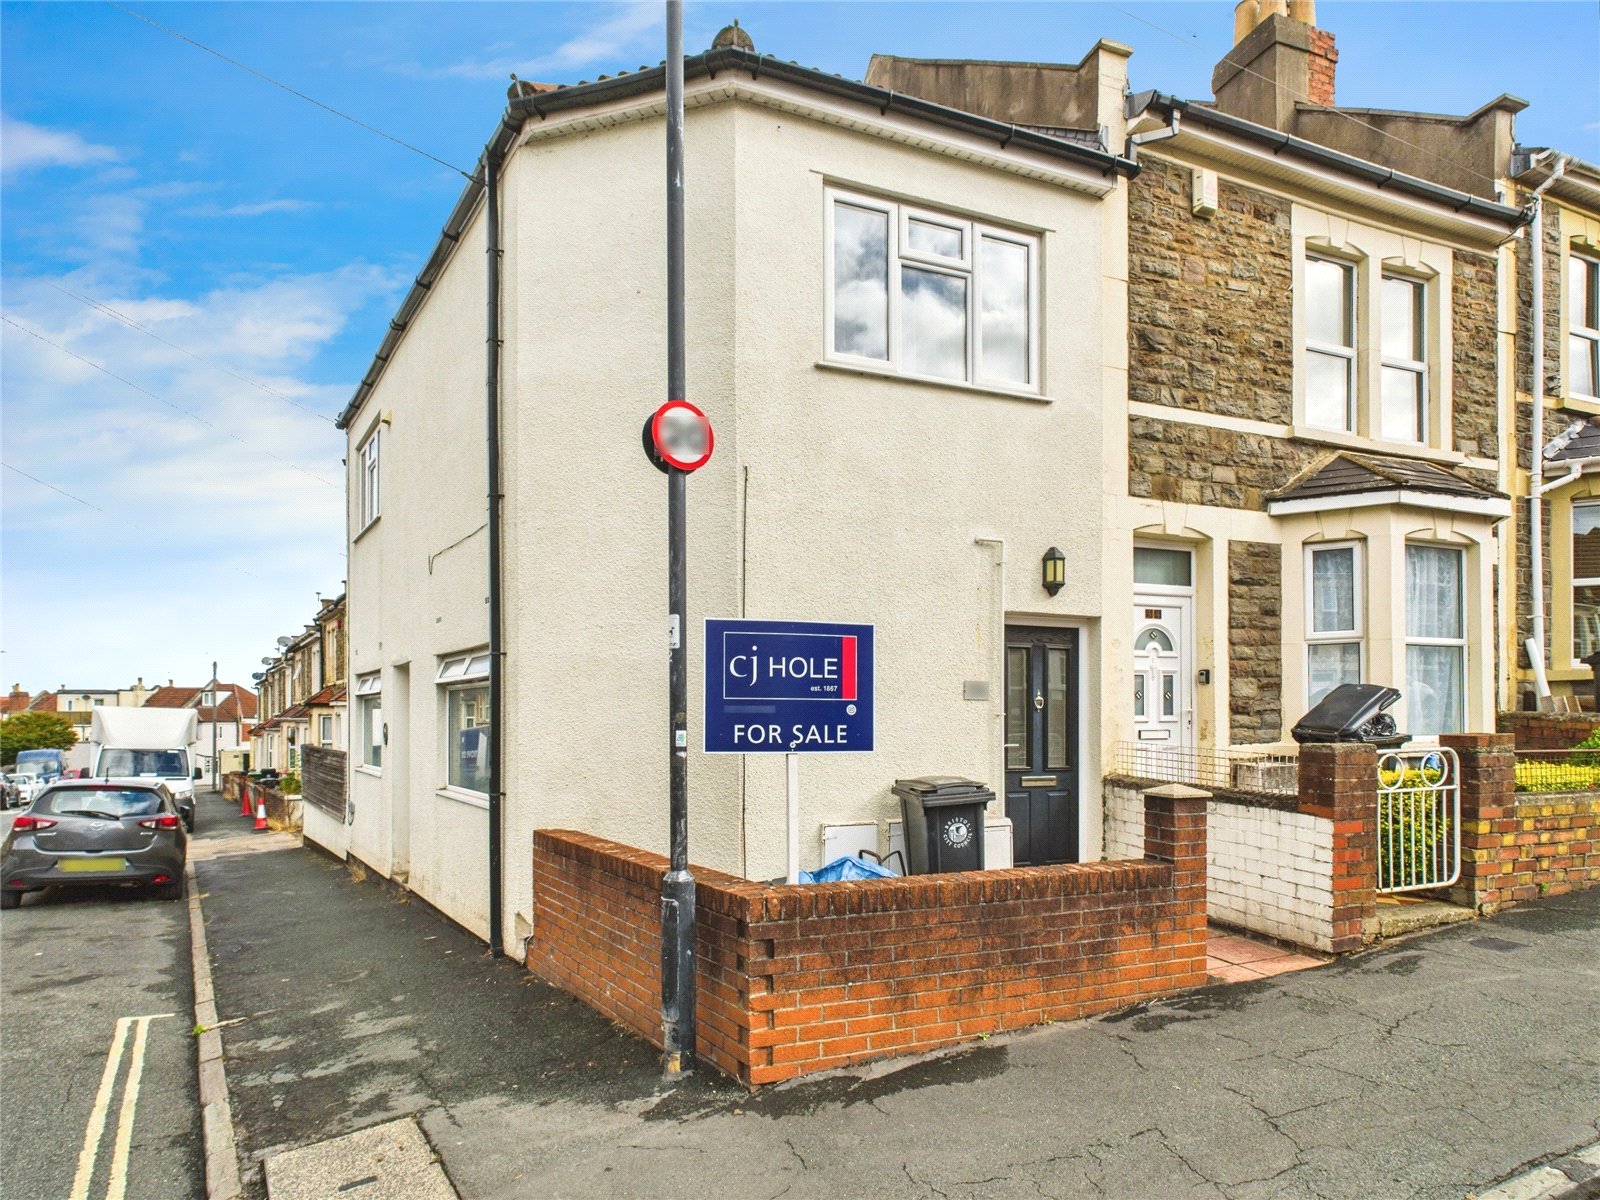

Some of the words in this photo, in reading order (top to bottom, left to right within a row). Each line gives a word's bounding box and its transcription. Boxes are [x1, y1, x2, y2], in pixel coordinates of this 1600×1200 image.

[769, 656, 838, 679] HOLE
[734, 724, 782, 744] FOR
[792, 724, 848, 745] SALE
[944, 817, 971, 829] BRISTOL
[943, 833, 953, 847] CITY
[953, 832, 973, 849] COUNCIL
